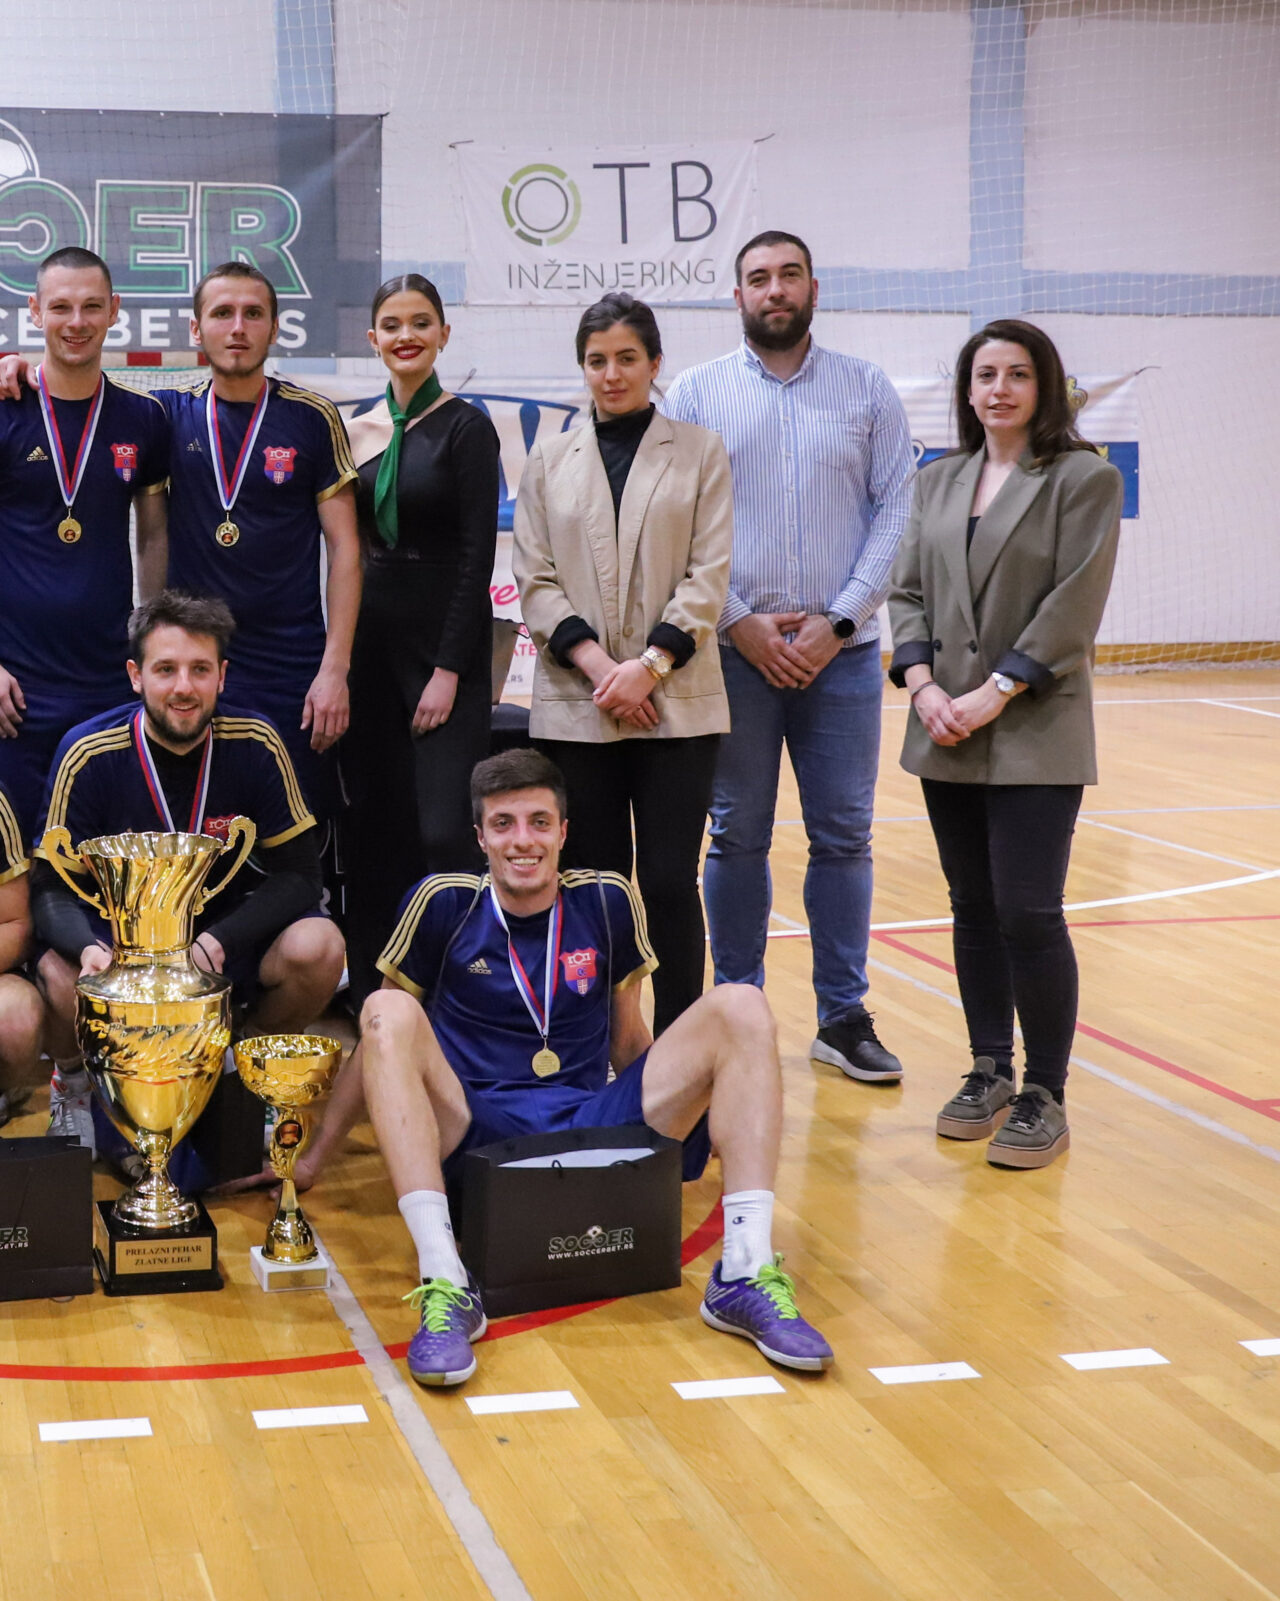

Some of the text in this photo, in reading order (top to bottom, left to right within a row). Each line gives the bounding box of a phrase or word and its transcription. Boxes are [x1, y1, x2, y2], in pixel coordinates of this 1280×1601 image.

[501, 160, 718, 248] OTB
[507, 258, 716, 290] INŽENJERING
[125, 1245, 202, 1256] PRELAZNI PEHAR
[548, 1227, 634, 1253] SOCCER
[134, 1256, 192, 1266] ZLATNE LIGE
